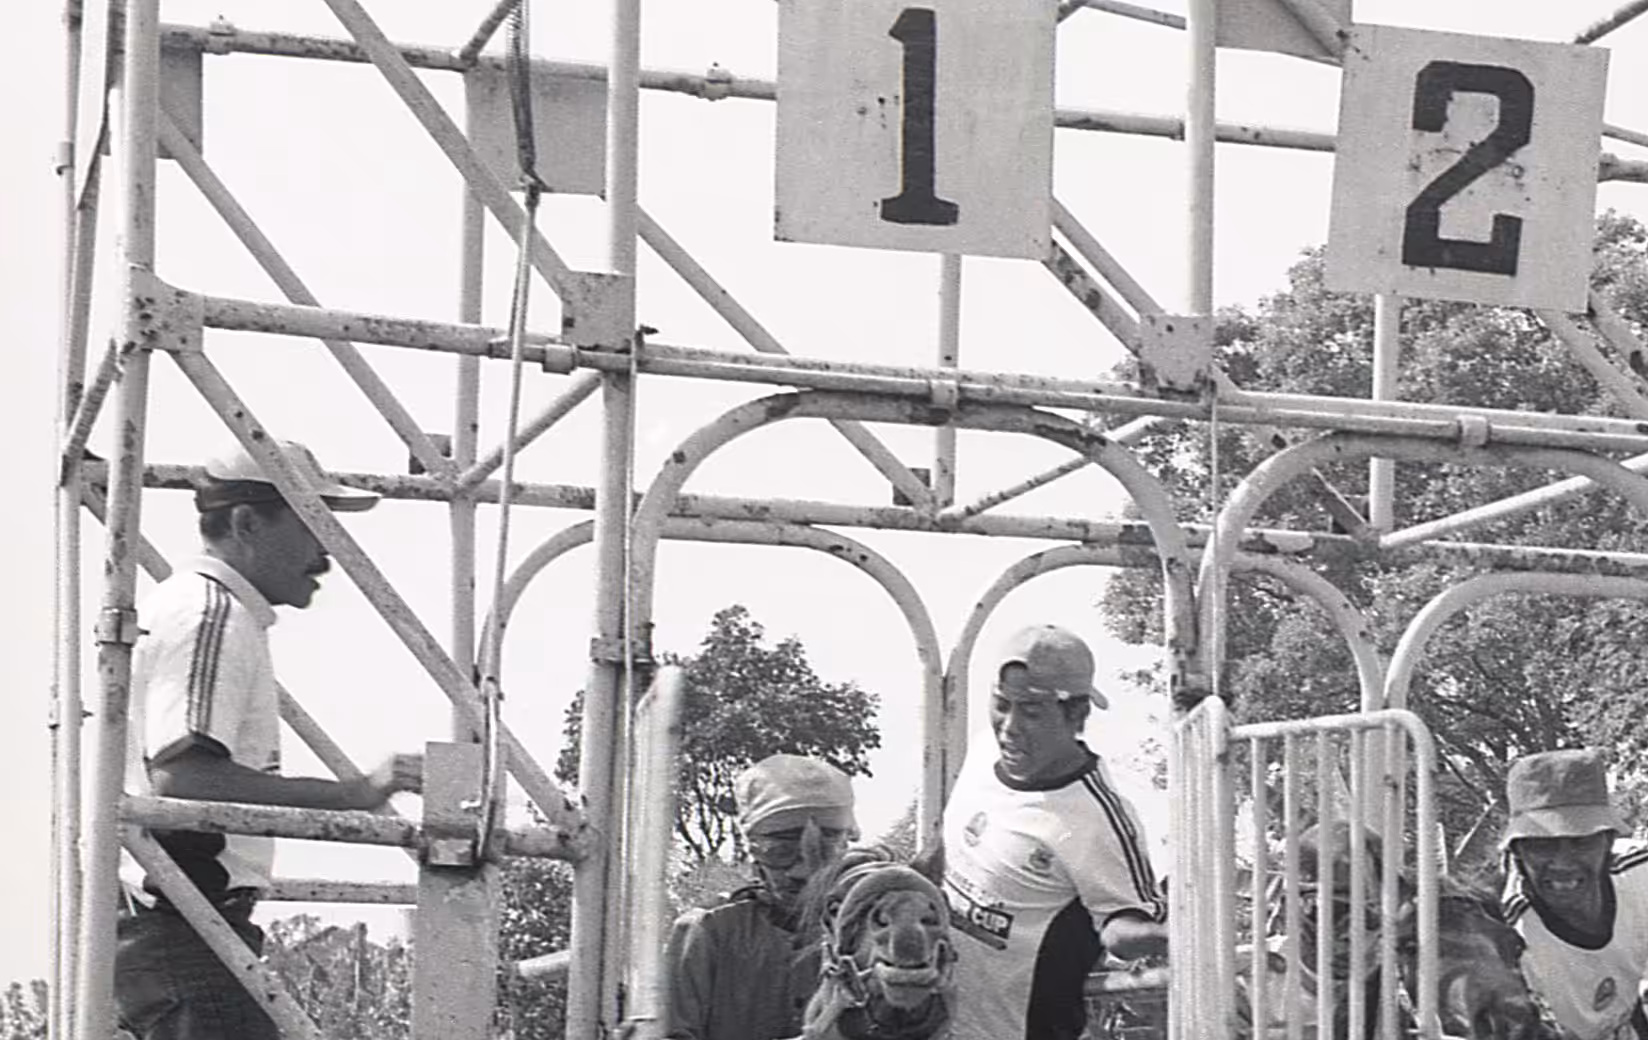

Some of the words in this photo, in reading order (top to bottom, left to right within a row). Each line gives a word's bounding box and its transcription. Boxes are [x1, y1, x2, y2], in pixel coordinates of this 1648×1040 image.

[880, 7, 958, 226] 1
[1402, 60, 1534, 276] 2
[971, 906, 1008, 933] CUP
